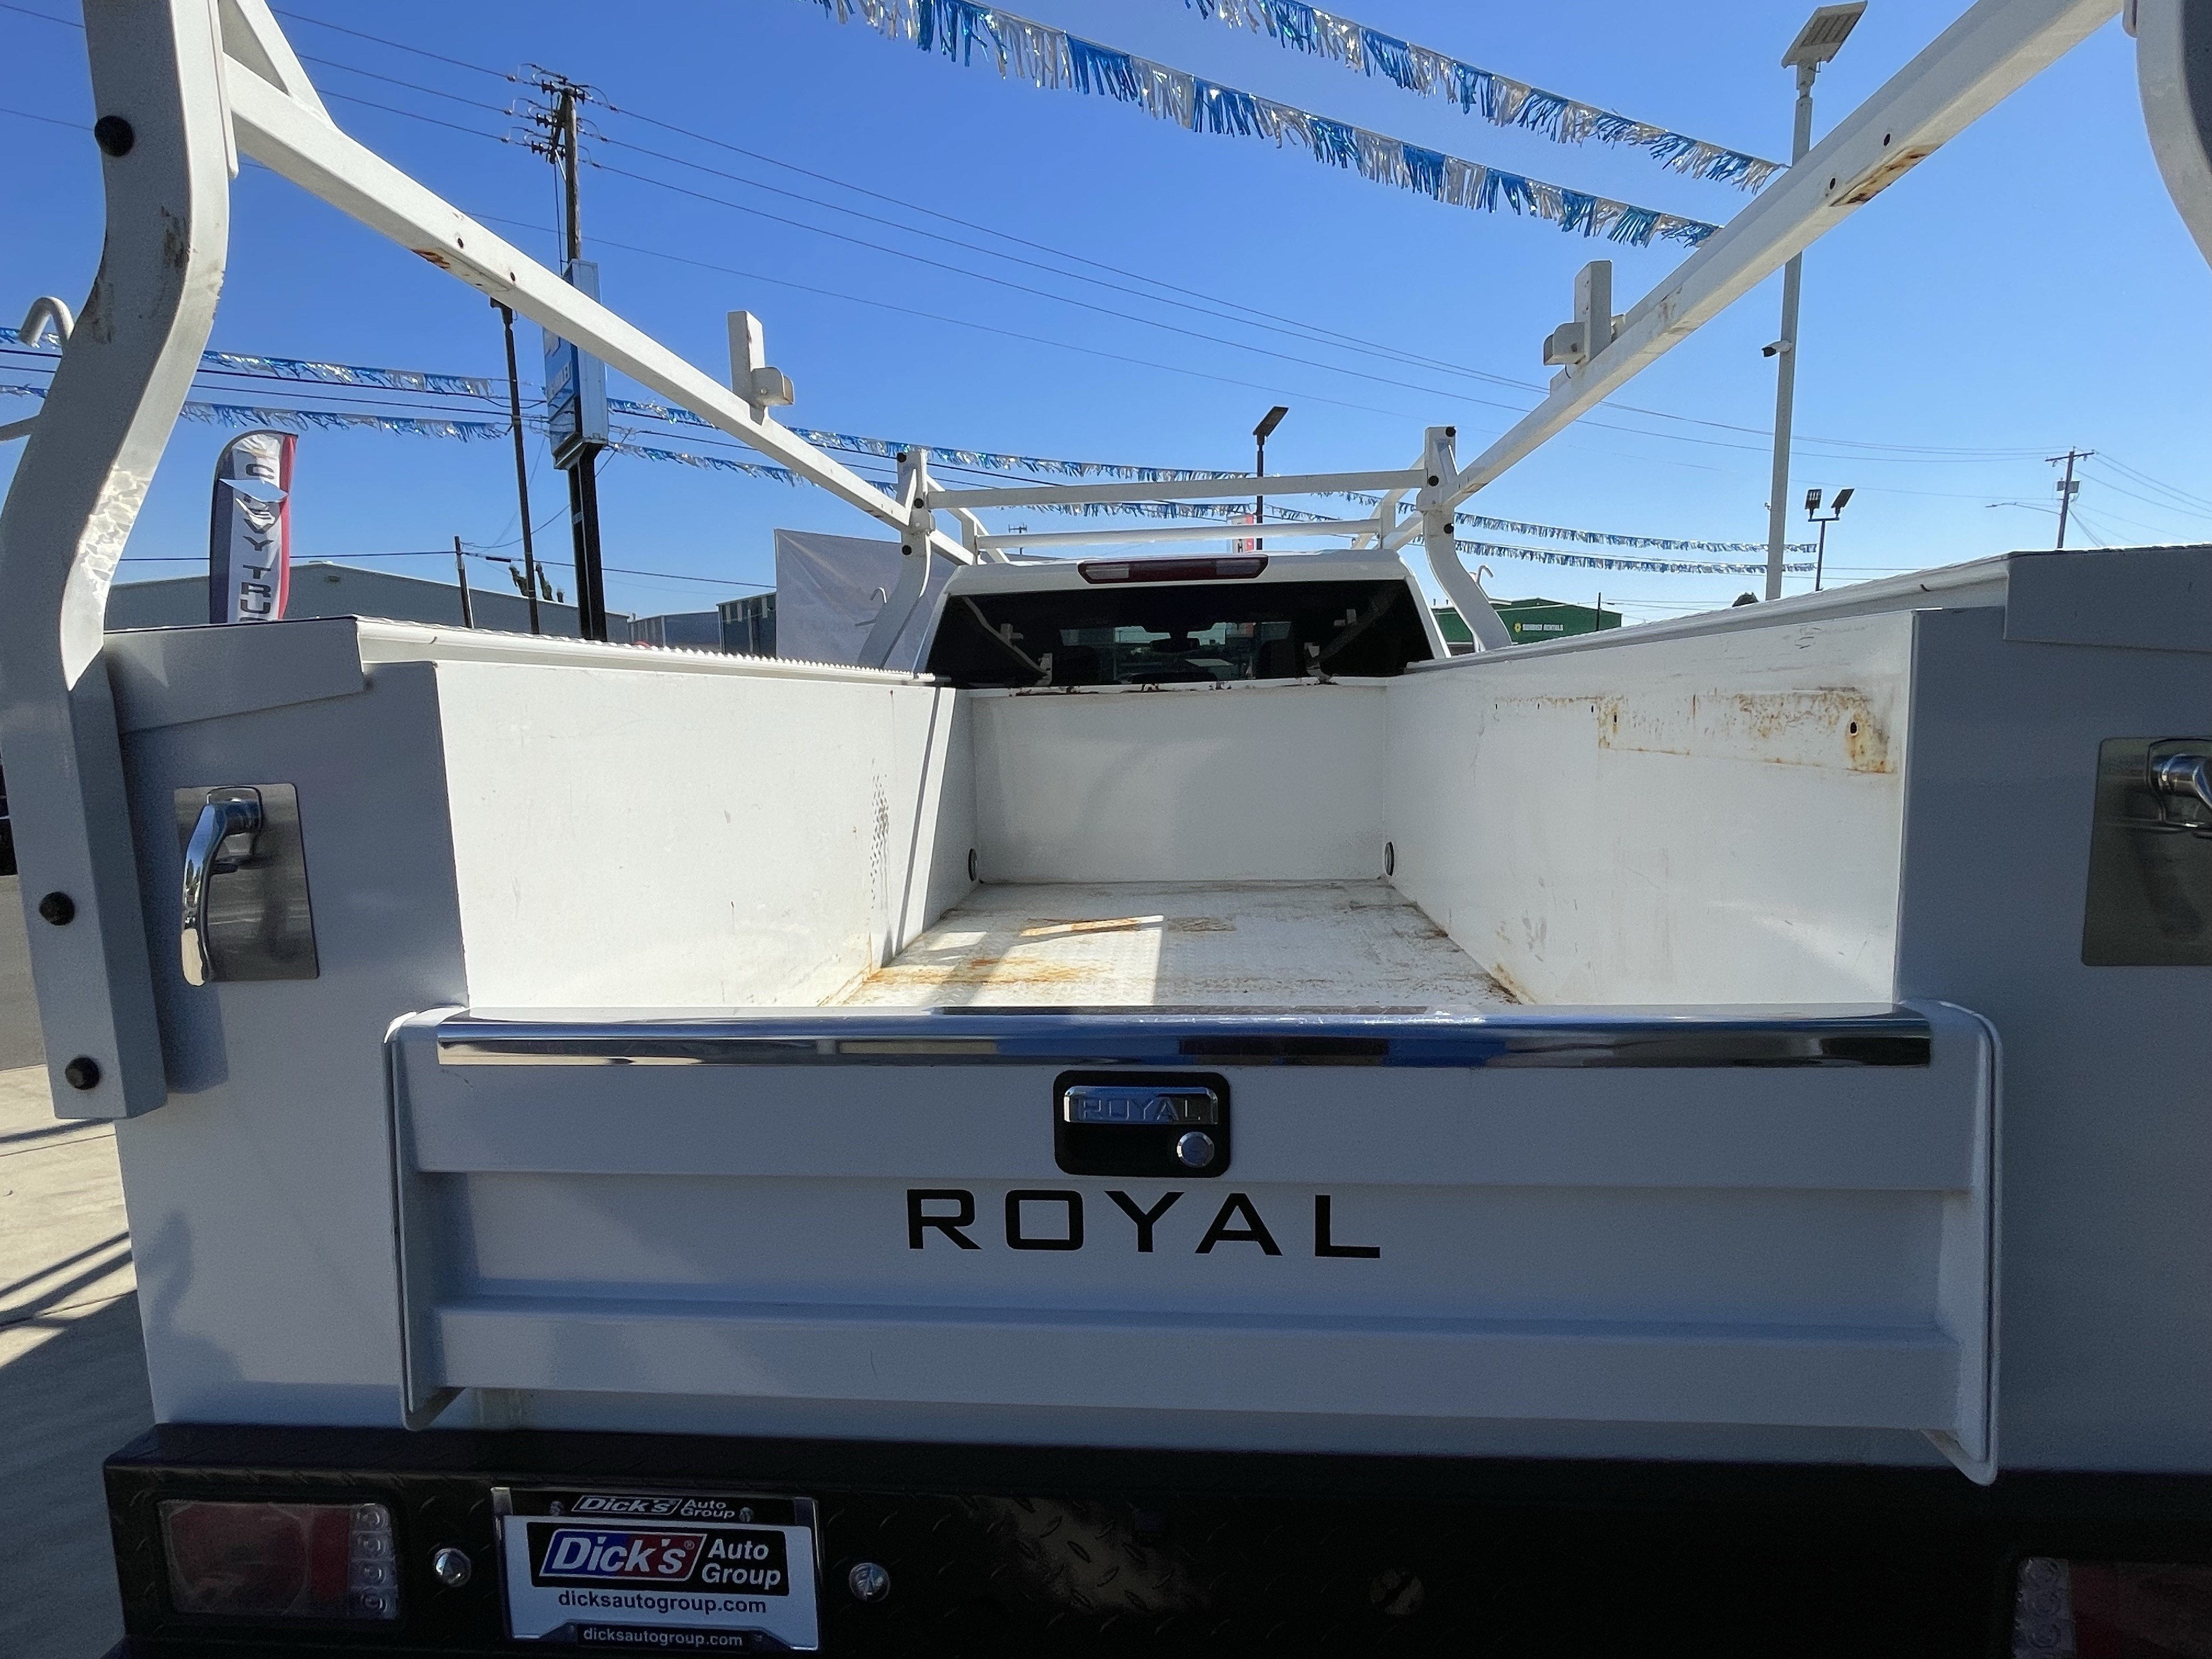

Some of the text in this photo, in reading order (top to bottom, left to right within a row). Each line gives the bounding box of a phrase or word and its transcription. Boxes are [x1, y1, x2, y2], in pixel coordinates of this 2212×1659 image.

[239, 564, 271, 622] TRU
[1077, 1097, 1201, 1121] ROYAL
[906, 1189, 1381, 1259] ROYAL
[680, 1508, 735, 1519] Group
[684, 1499, 726, 1509] Auto
[708, 1538, 769, 1561] Auto
[702, 1562, 781, 1590] Group
[558, 1590, 766, 1615] dicksautogroup.com
[583, 1627, 743, 1647] dicksautogroup.com
